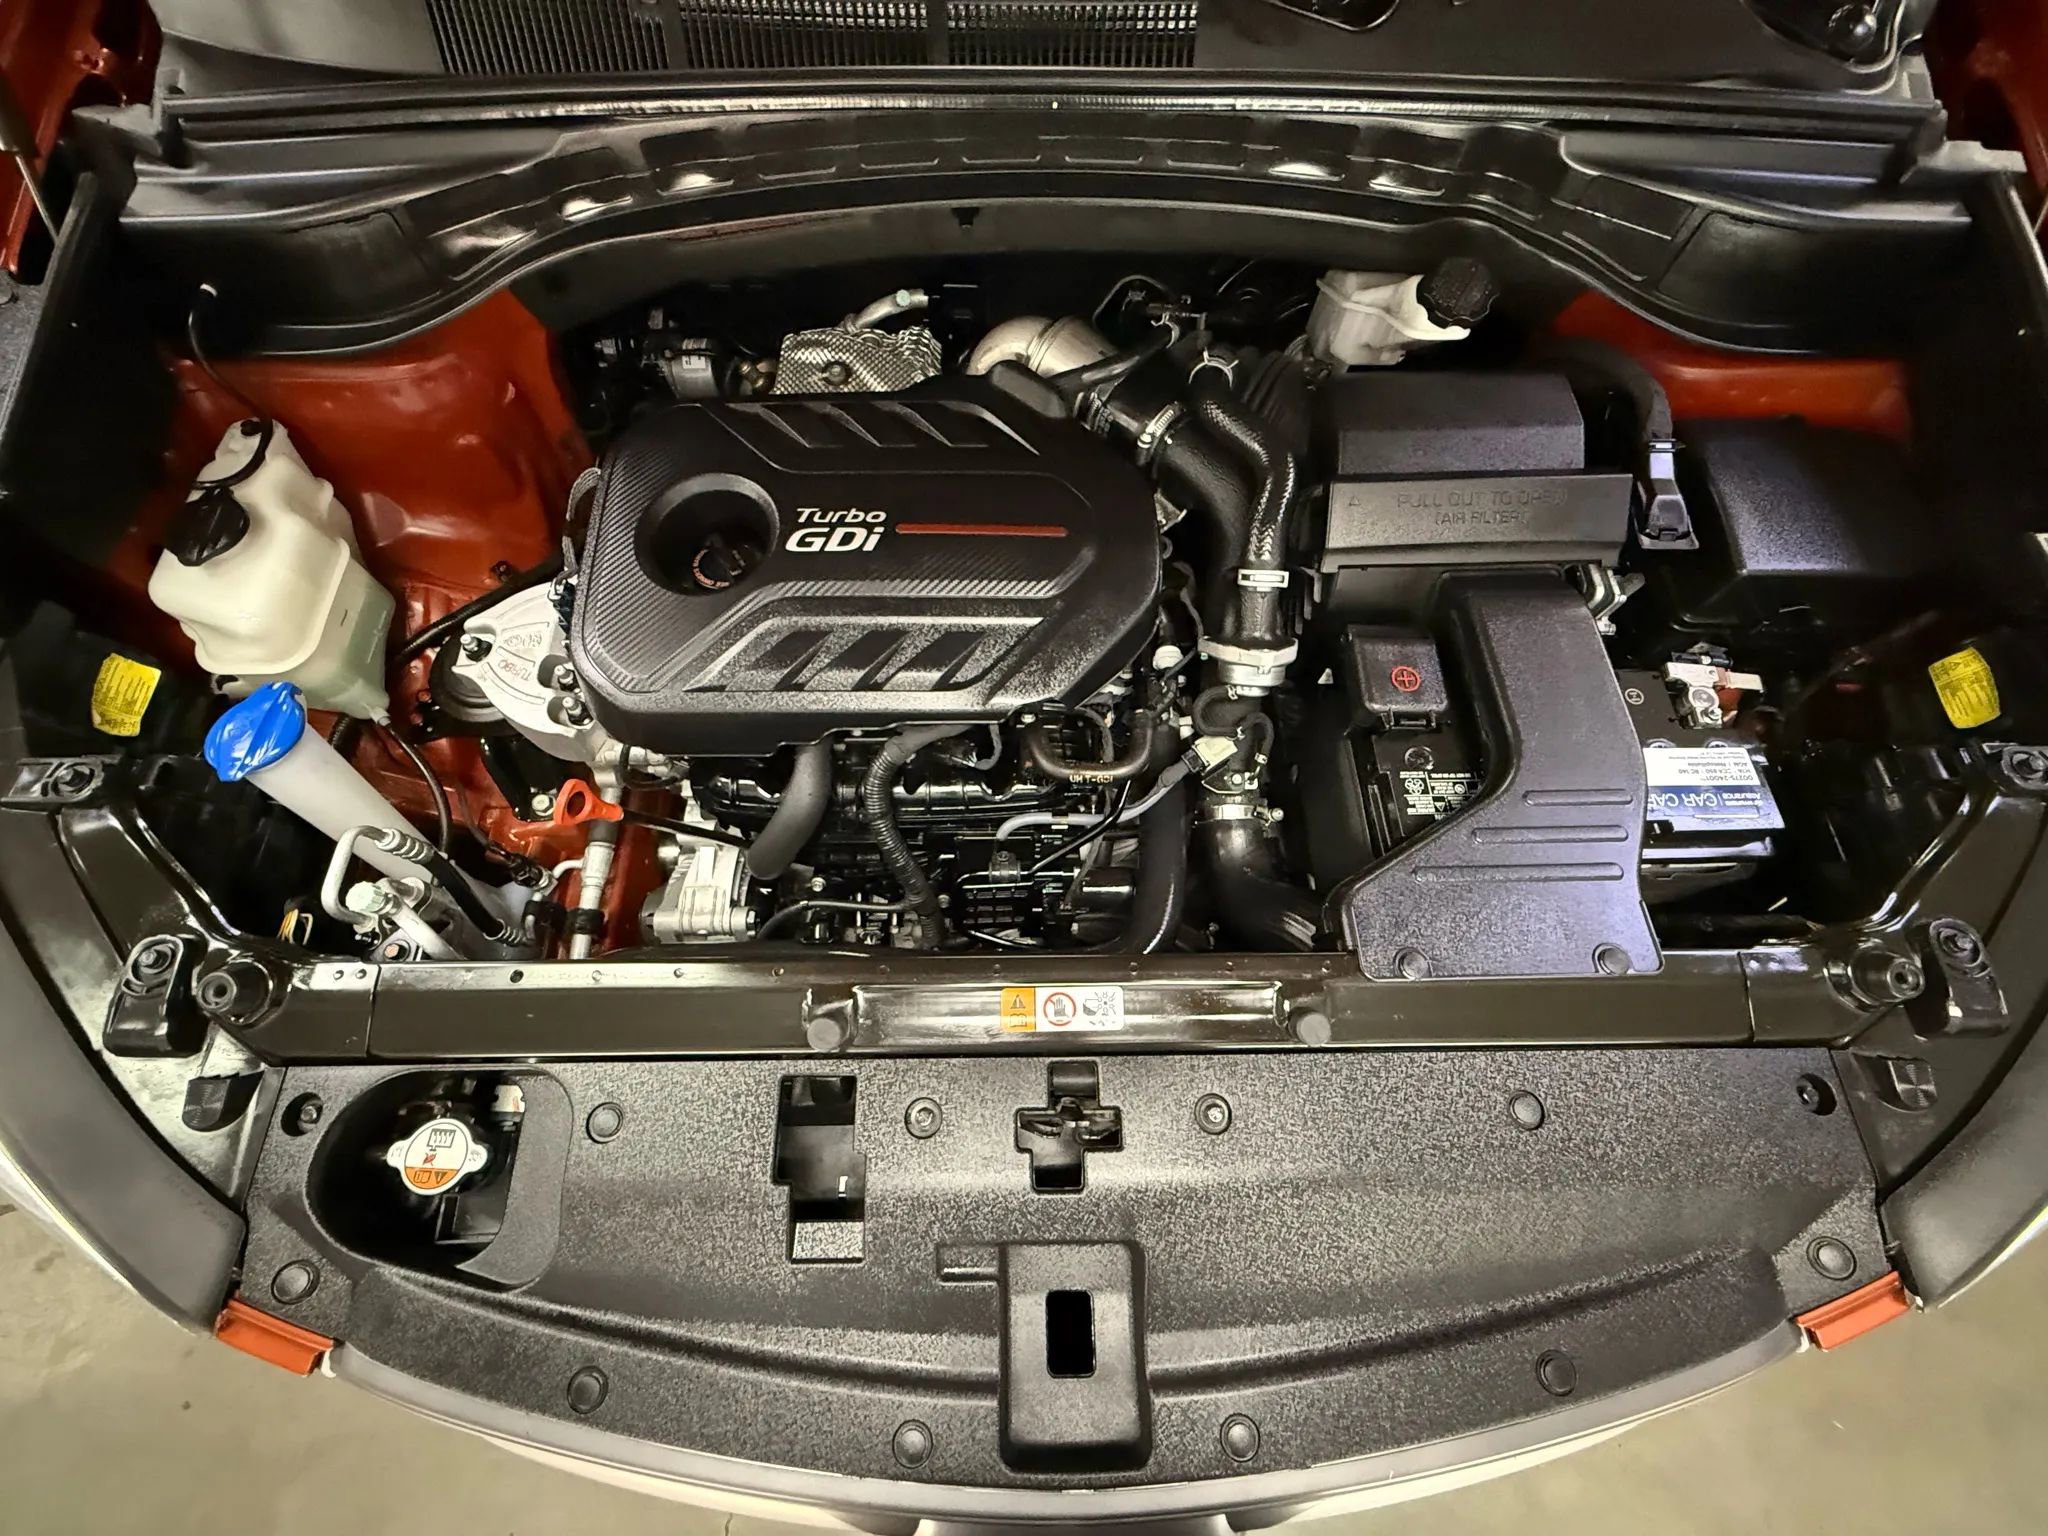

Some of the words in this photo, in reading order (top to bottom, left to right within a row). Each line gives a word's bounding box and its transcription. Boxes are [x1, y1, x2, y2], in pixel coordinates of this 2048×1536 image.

[1397, 491, 1442, 508] PULL
[1447, 490, 1482, 507] OUT
[1490, 489, 1513, 506] TO
[796, 507, 887, 523] Turbo
[785, 526, 885, 552] GDi
[498, 659, 533, 682] TURBO
[1681, 793, 1718, 807] CAR
